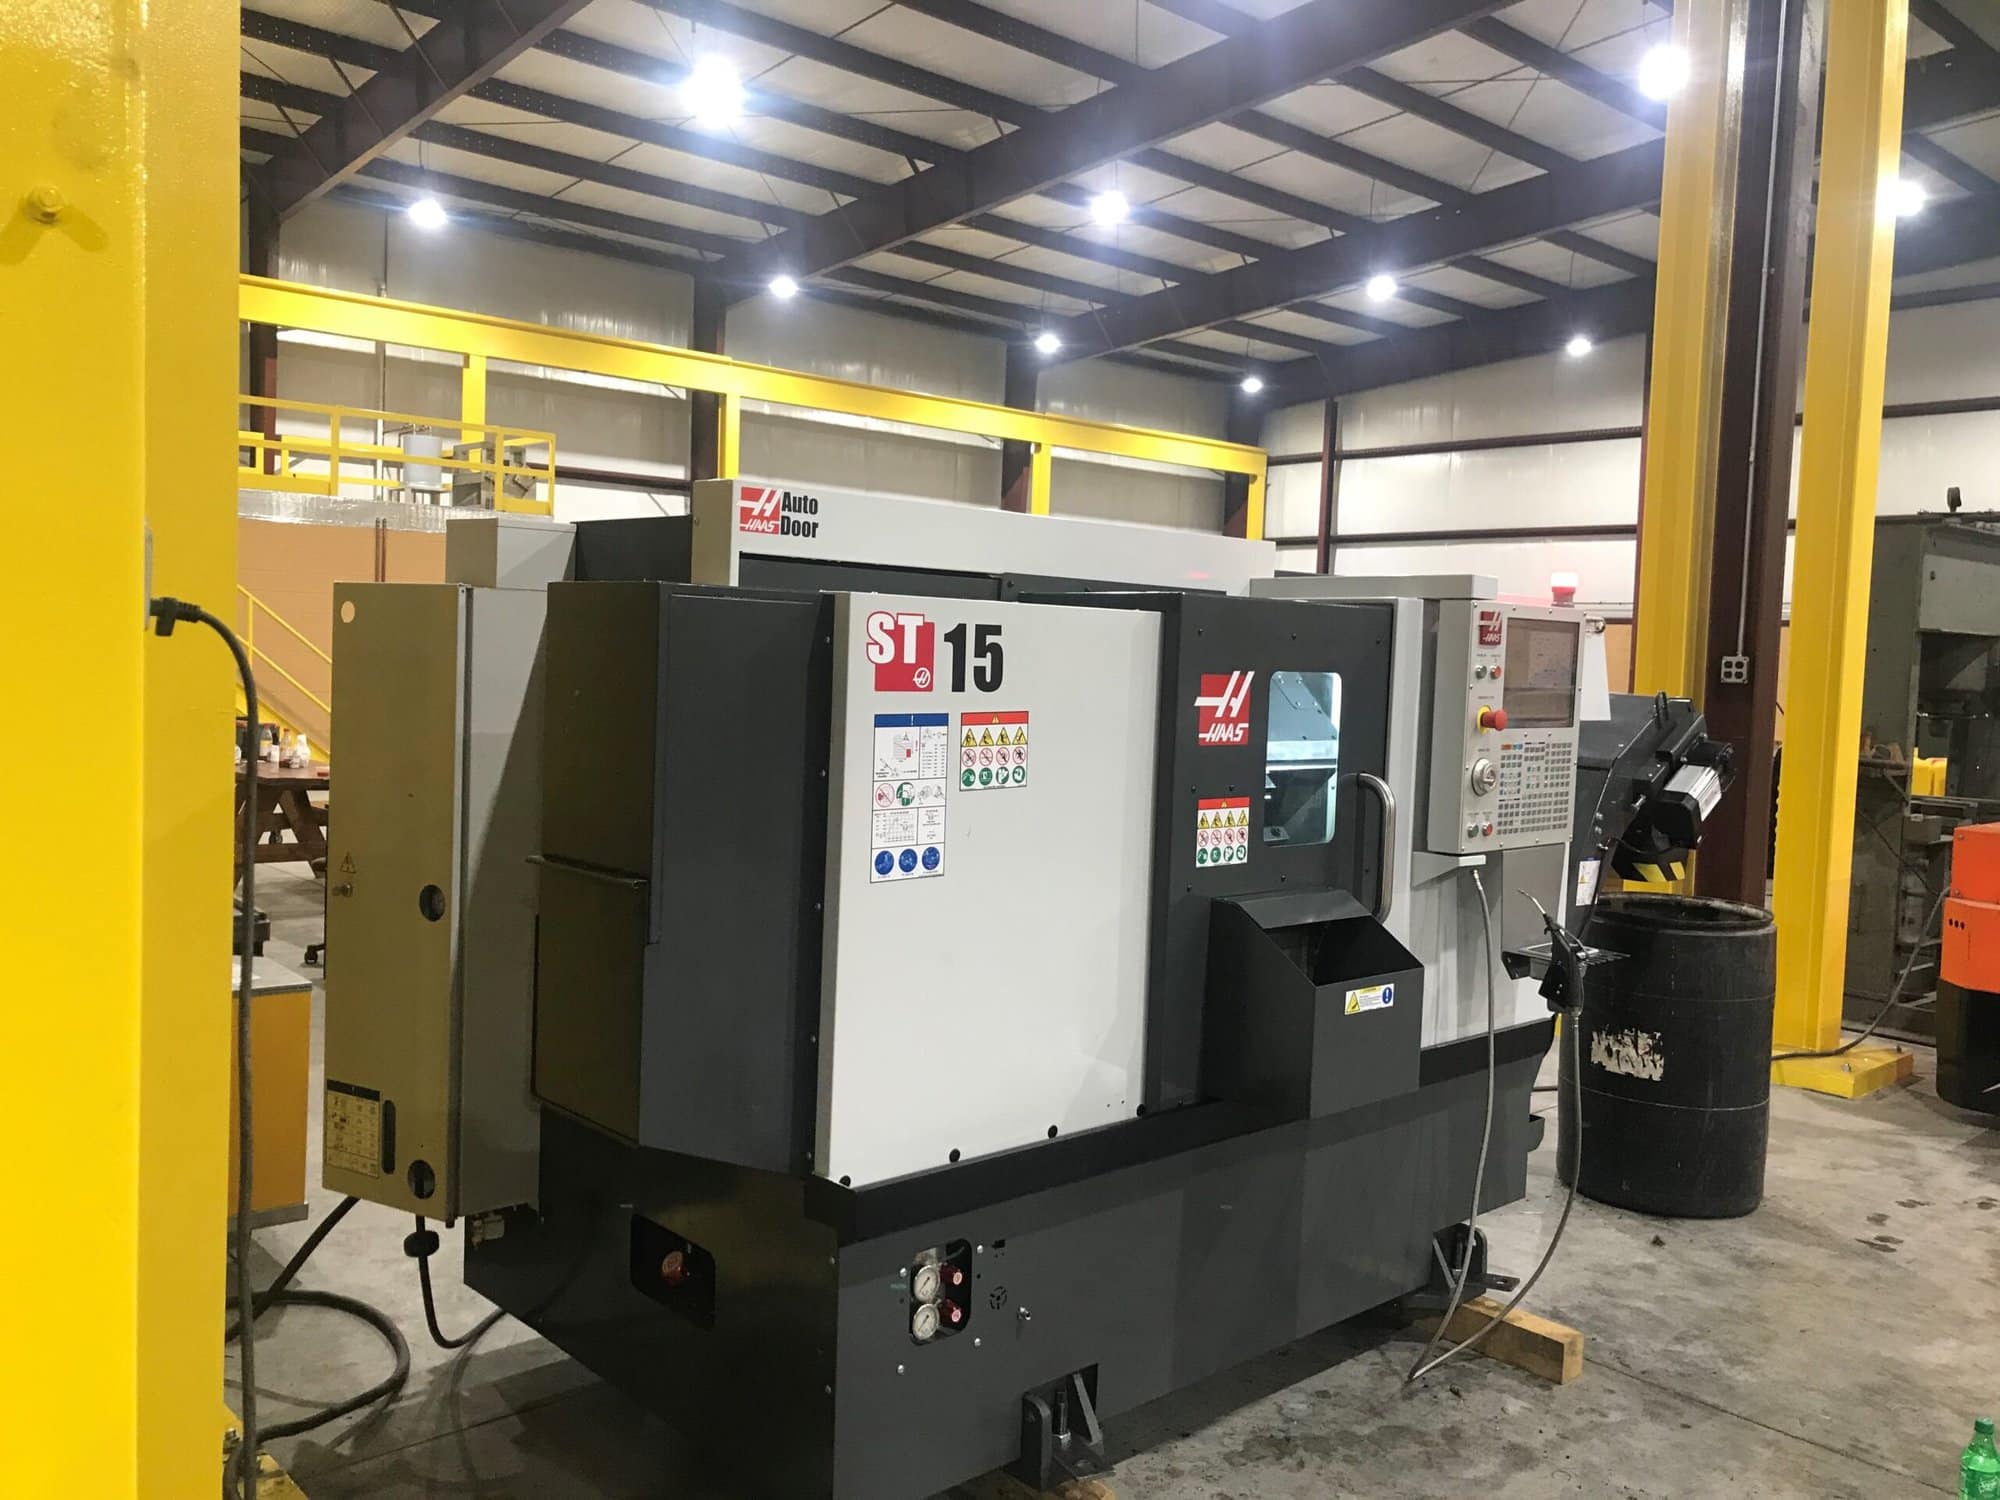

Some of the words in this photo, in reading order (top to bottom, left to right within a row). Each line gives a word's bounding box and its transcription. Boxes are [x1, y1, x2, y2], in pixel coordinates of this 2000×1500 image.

[782, 491, 819, 515] Auto
[740, 518, 780, 532] HAAS
[780, 515, 819, 539] Door
[866, 611, 925, 664] ST
[944, 623, 1003, 692] 15
[1198, 722, 1249, 743] HAAS
